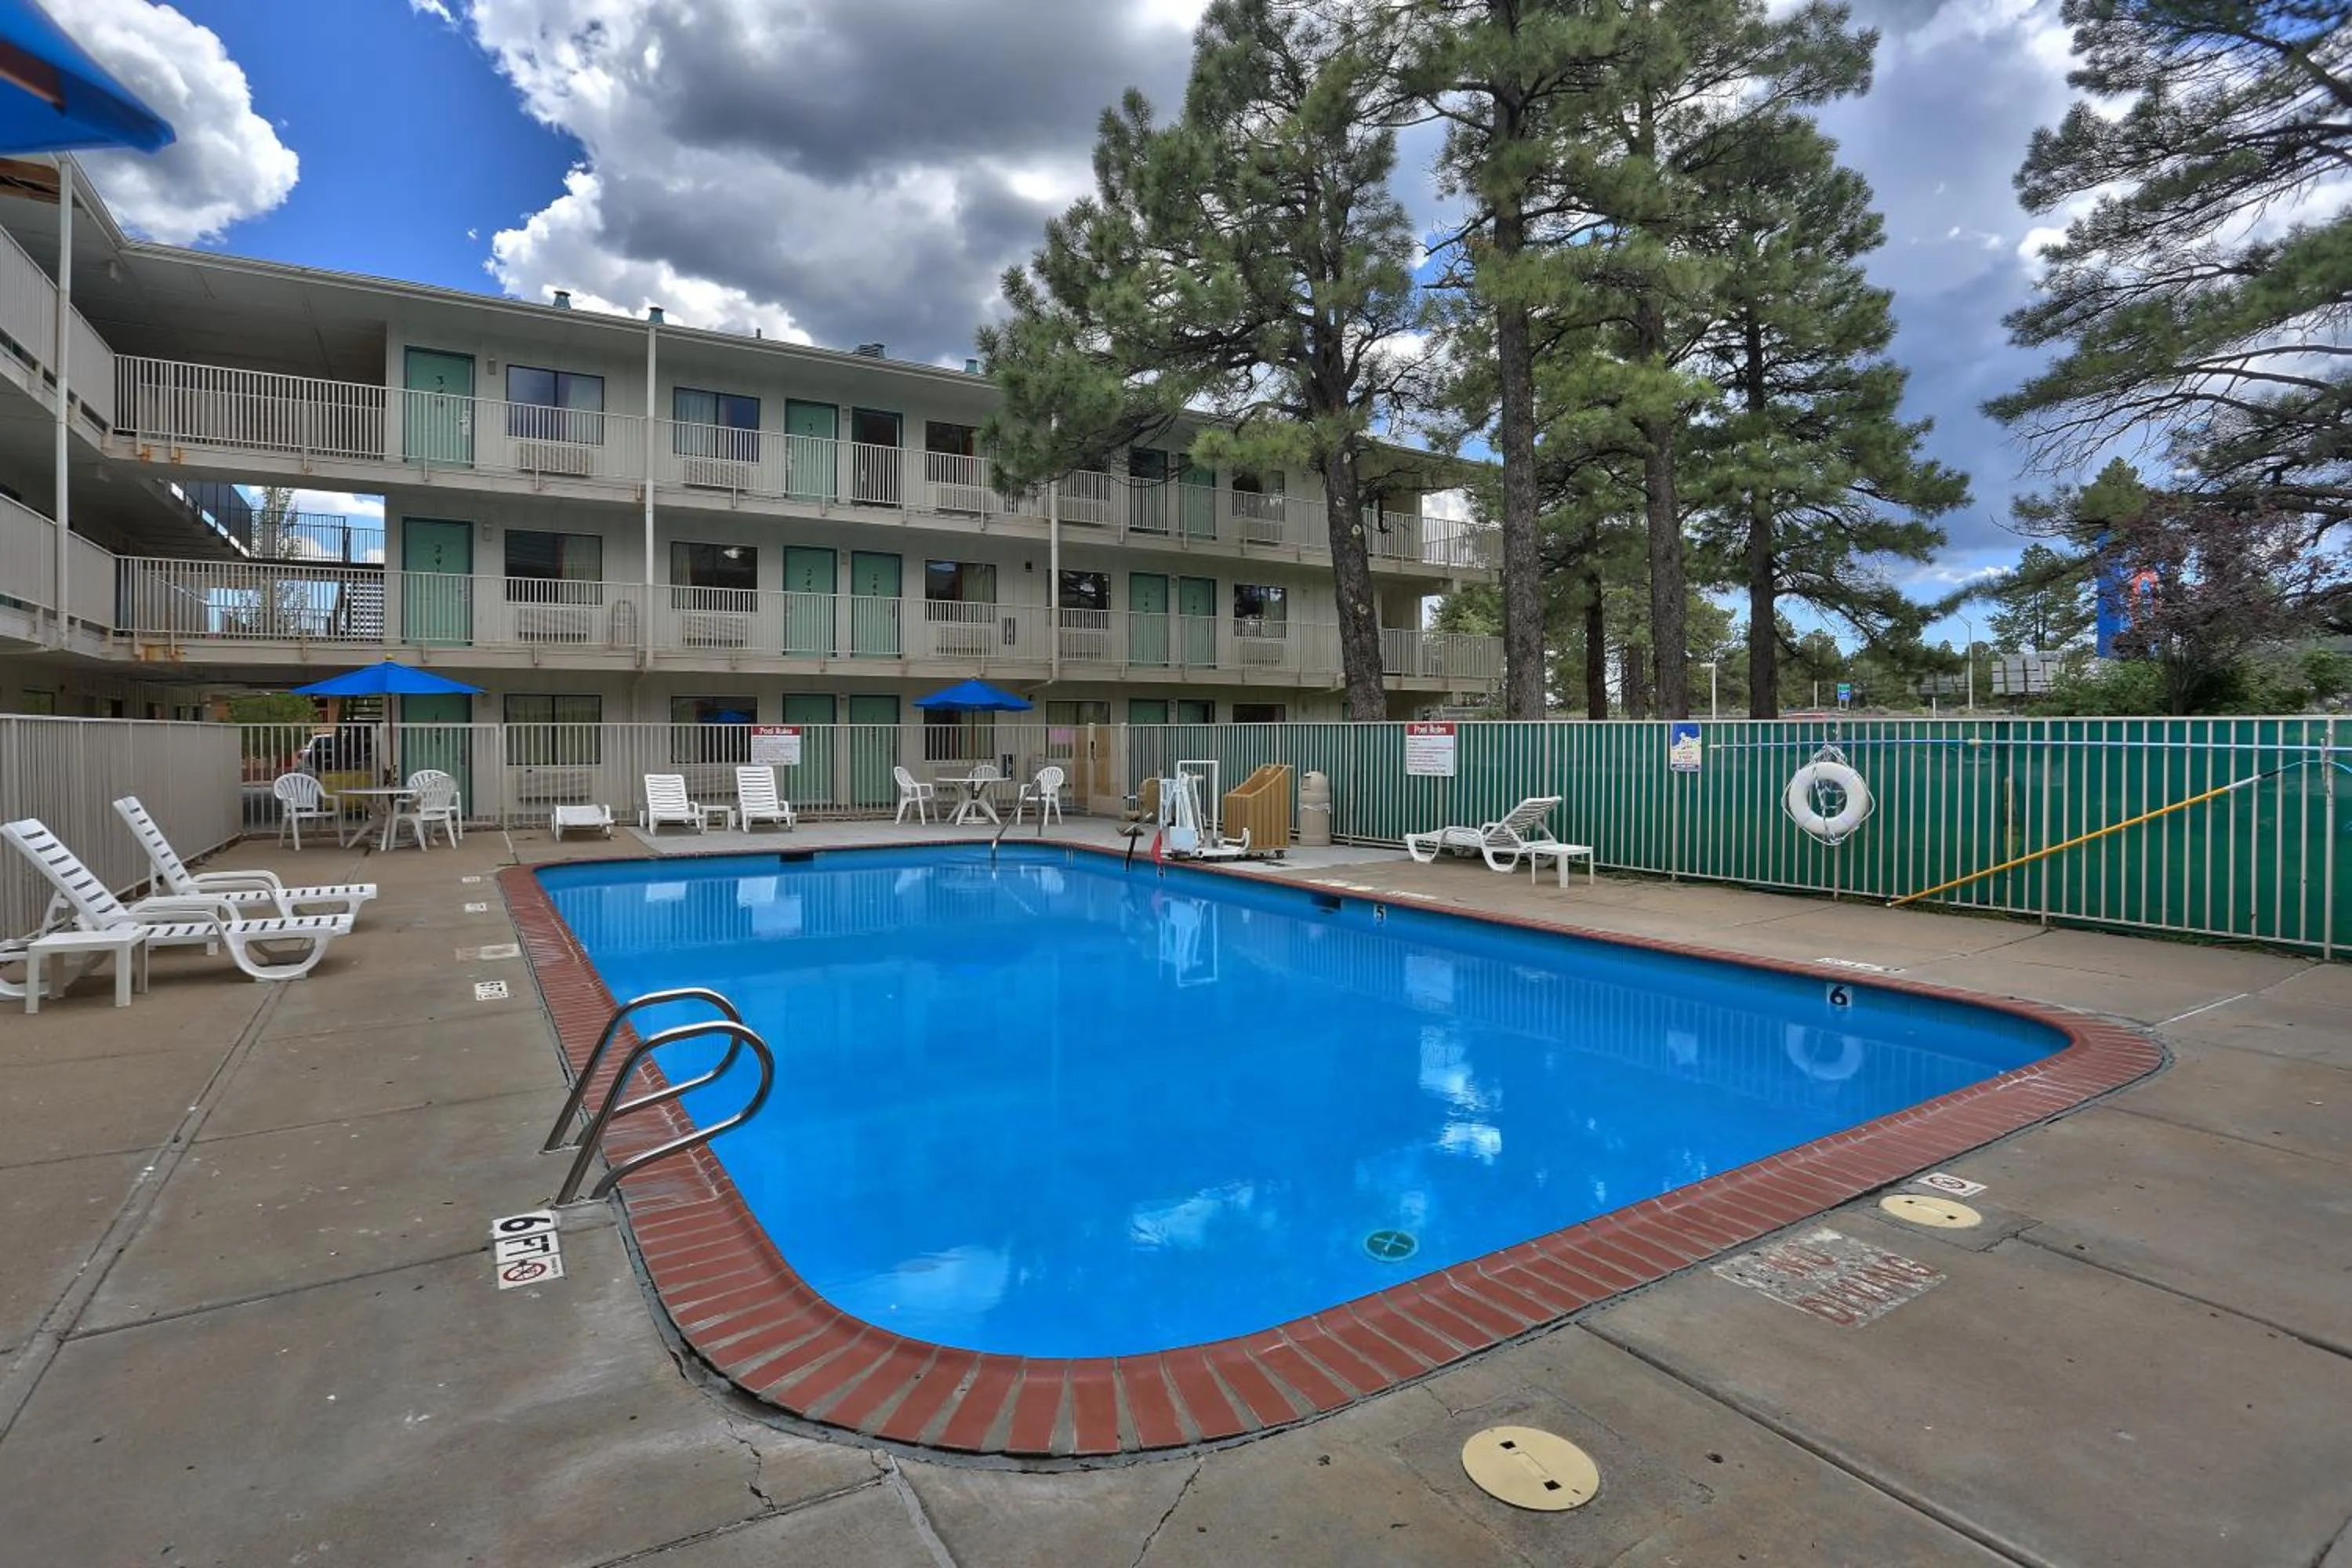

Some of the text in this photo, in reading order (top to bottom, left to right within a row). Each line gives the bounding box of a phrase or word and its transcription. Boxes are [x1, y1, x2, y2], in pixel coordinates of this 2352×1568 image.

[1376, 905, 1384, 920] 5
[1829, 985, 1848, 1006] 6
[499, 1216, 551, 1257] 6 FT
[1797, 1254, 1938, 1326] DIVING
